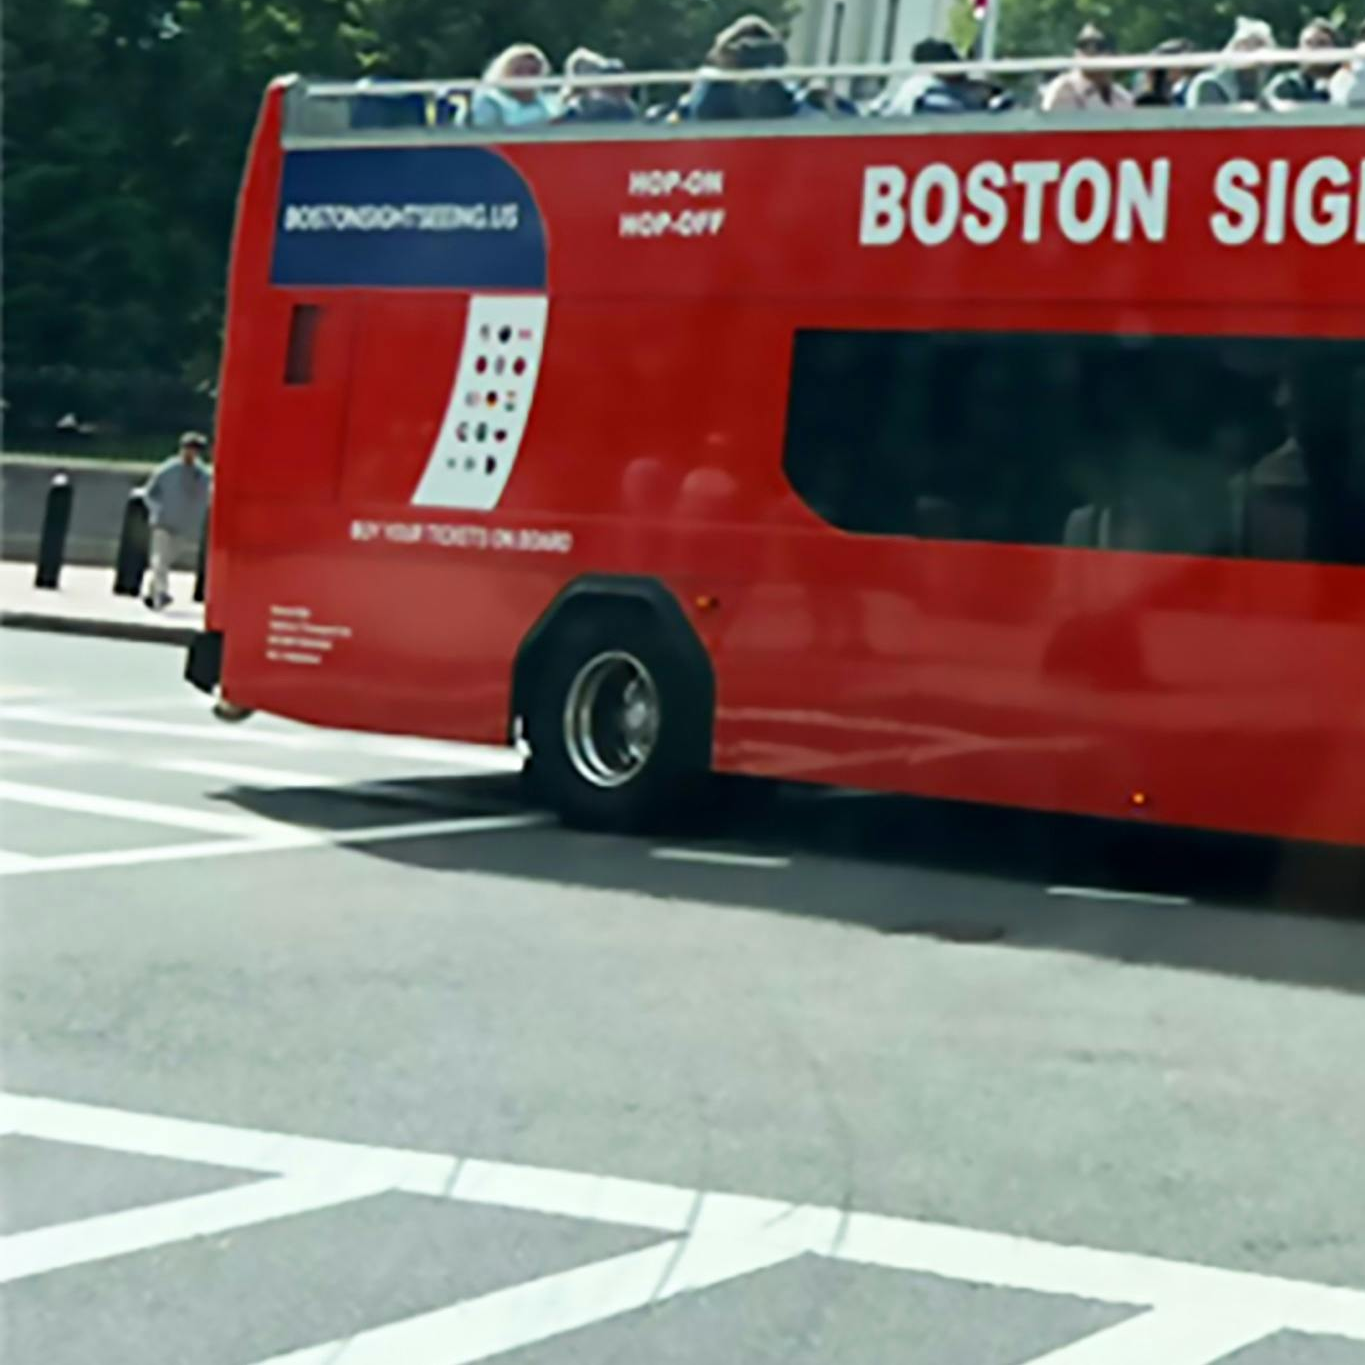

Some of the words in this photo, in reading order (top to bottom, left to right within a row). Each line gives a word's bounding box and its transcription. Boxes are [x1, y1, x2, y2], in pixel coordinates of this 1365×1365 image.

[629, 170, 723, 195] HOP-ON
[859, 158, 1170, 246] BOSTON
[285, 204, 518, 230] BOSTONSIGHTSEEING.US
[620, 210, 725, 236] HOP-OFF
